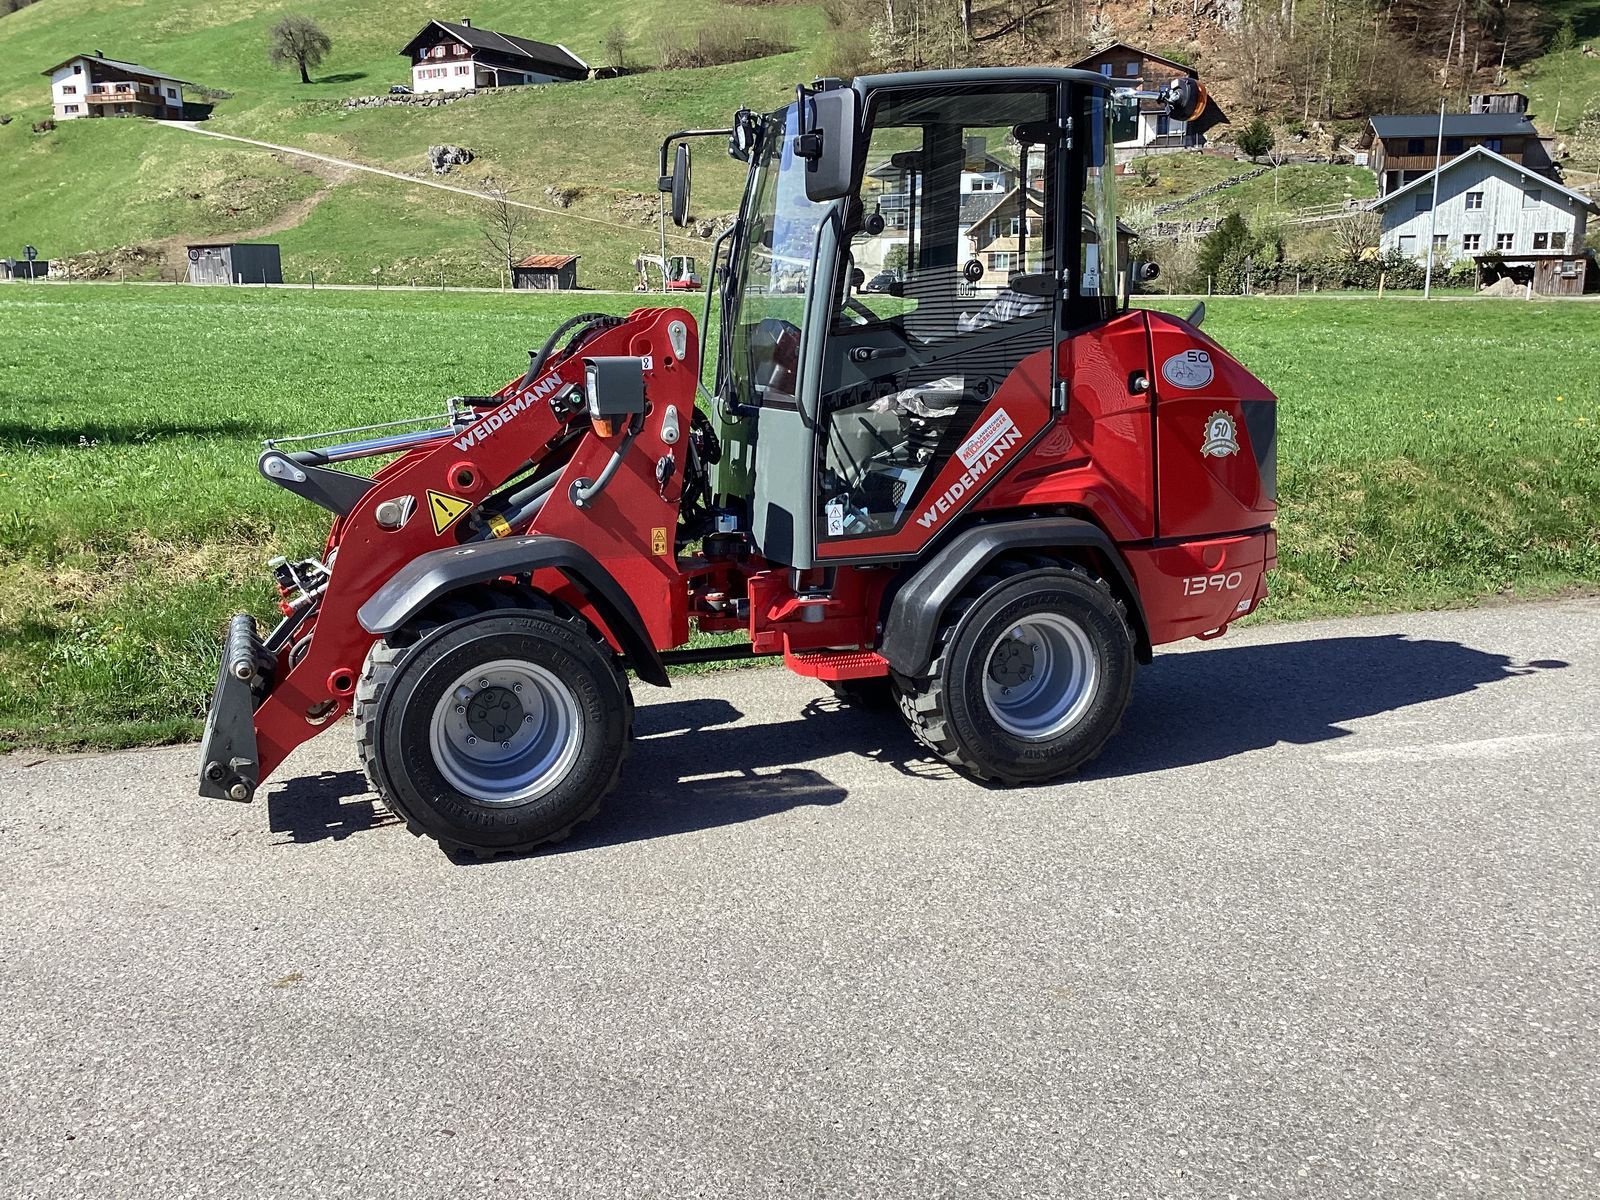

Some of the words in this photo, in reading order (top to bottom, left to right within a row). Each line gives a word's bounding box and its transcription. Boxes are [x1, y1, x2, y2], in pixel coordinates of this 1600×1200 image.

[1187, 351, 1209, 363] 50
[452, 372, 563, 452] WEIDEMANN
[1213, 422, 1228, 438] 50
[916, 426, 1023, 529] WEIDEMANN
[1182, 571, 1242, 596] 1390
